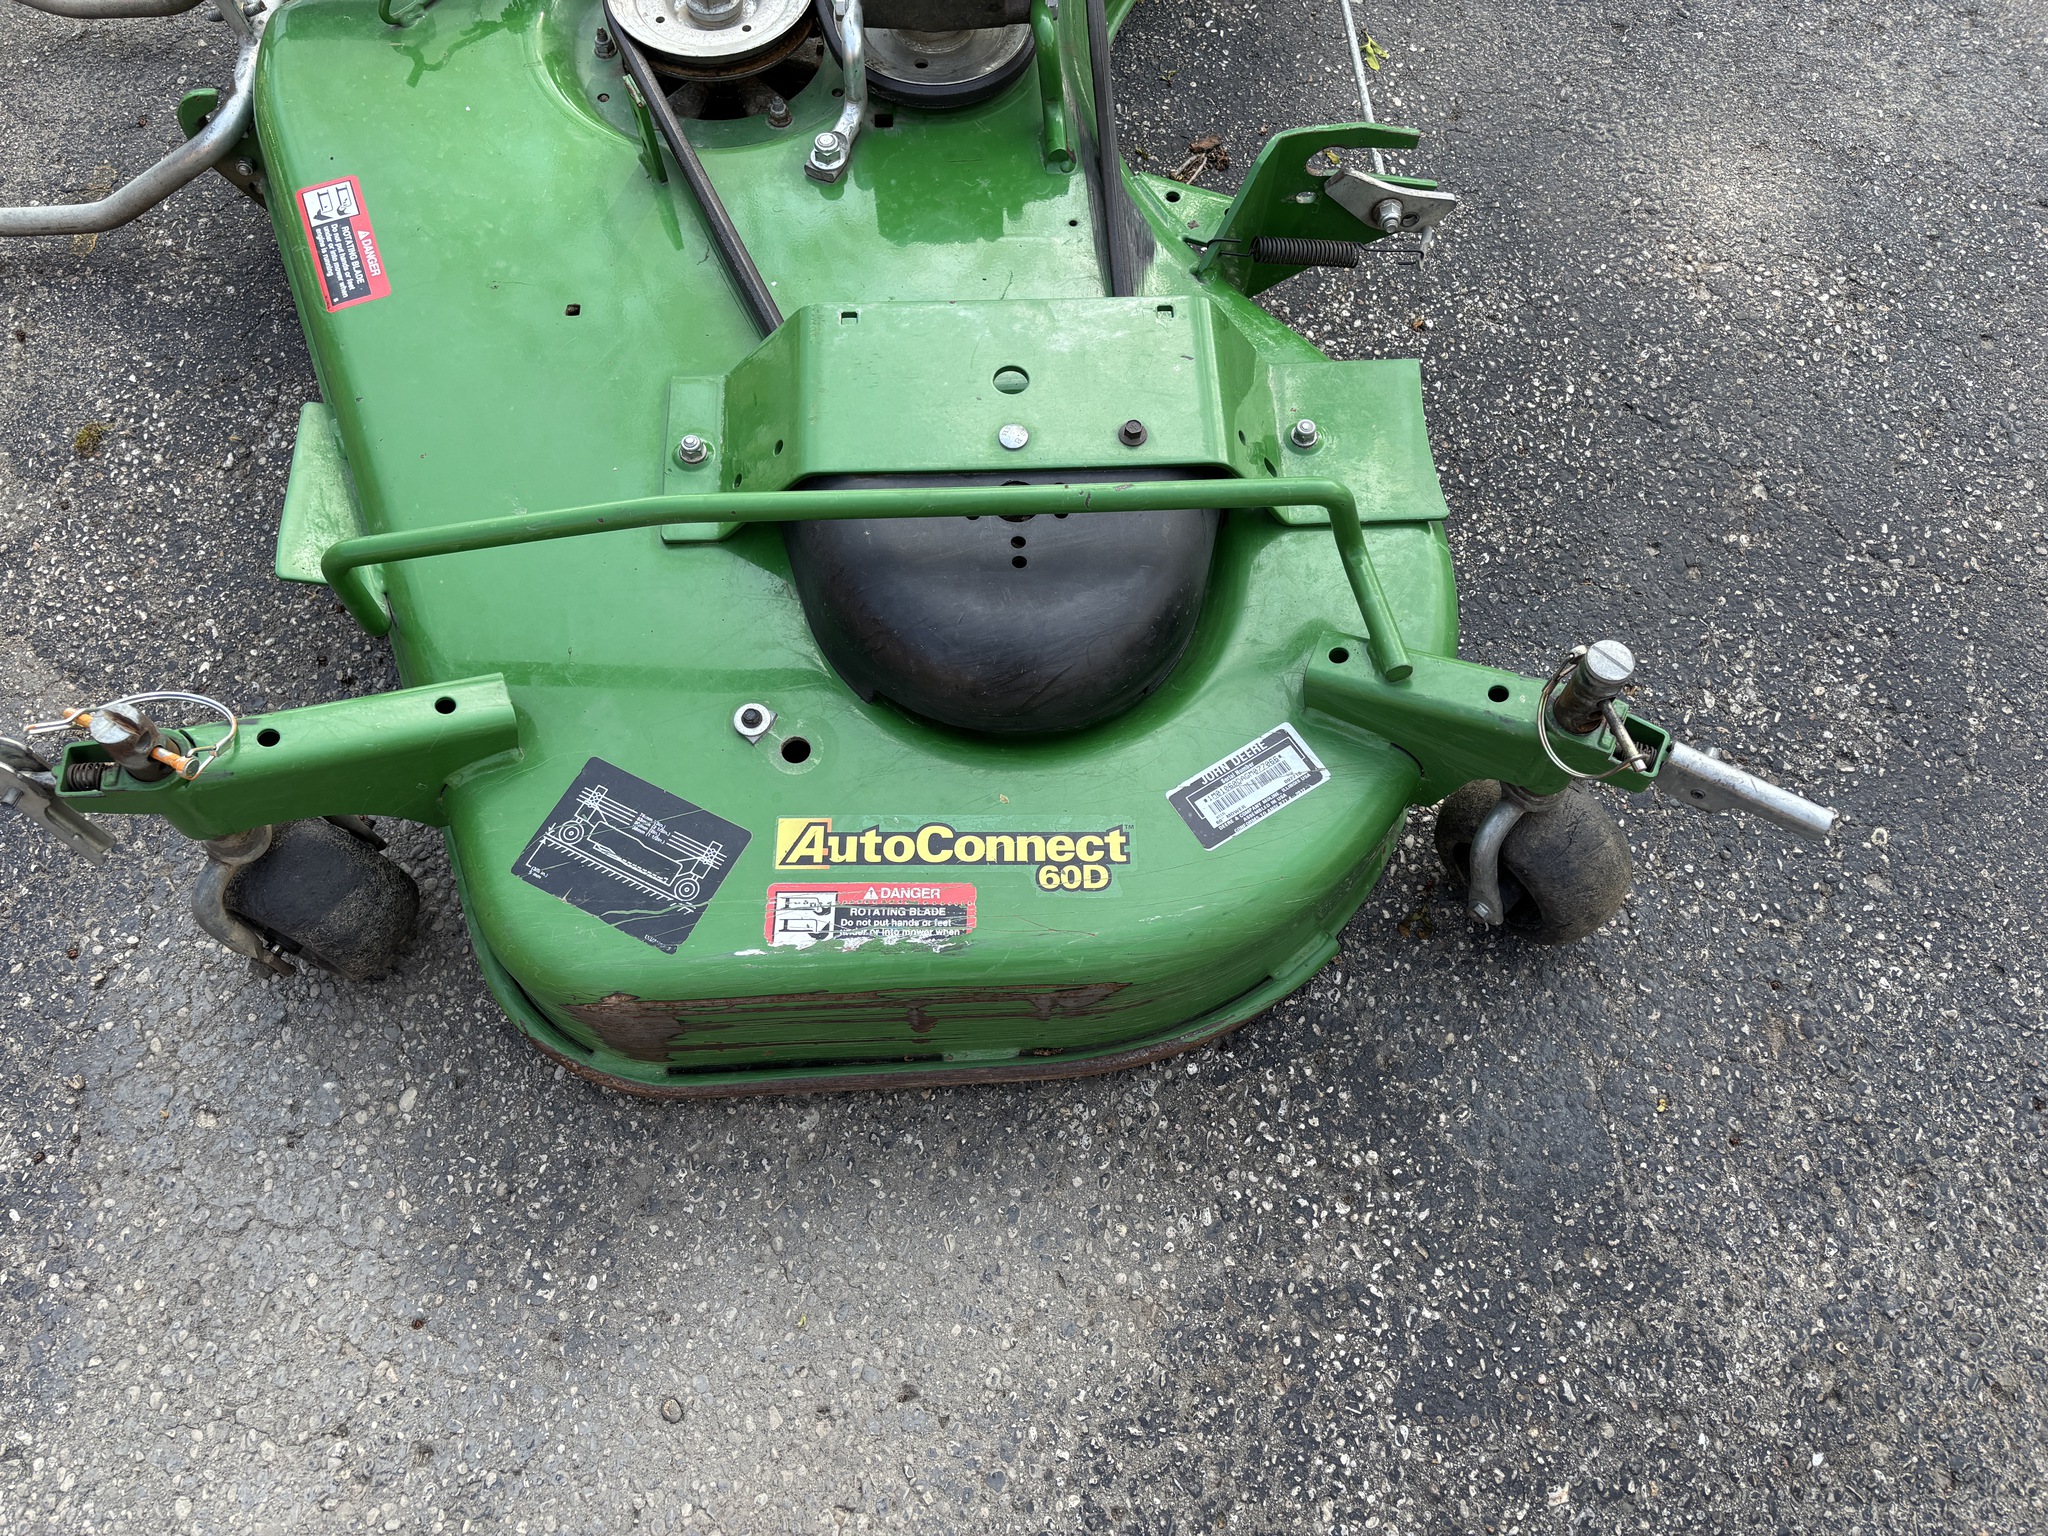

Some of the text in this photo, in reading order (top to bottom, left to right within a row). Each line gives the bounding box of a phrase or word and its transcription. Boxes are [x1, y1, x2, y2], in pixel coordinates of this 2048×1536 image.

[331, 223, 338, 232] Do
[333, 232, 341, 242] not
[316, 228, 325, 247] engine
[323, 254, 334, 277] running
[335, 243, 344, 253] put
[341, 226, 365, 284] ROTATING BLADE
[362, 239, 381, 276] DANGER
[323, 226, 332, 242] under
[330, 250, 338, 261] into
[334, 262, 343, 281] mower
[339, 282, 348, 298] when
[339, 253, 349, 271] hands
[346, 278, 355, 290] feet
[1201, 741, 1268, 785] JOHN DEERE
[1221, 762, 1254, 783] Serial Number
[1218, 819, 1234, 830] DEERE
[1239, 802, 1262, 818] COMPANY
[1301, 773, 1311, 781] USA
[1243, 803, 1271, 821] ASSEMBLED
[1276, 793, 1287, 801] USA
[1226, 805, 1246, 818] MOWER
[786, 824, 1129, 865] AutoConnect
[1038, 864, 1110, 891] 60D
[880, 888, 940, 899] DANGER
[850, 908, 946, 916] ROTATING BLADE
[840, 919, 854, 927] Do
[856, 919, 871, 927] not
[873, 919, 889, 929] put
[891, 919, 919, 927] hands
[934, 918, 952, 927] feet
[935, 928, 961, 936] when
